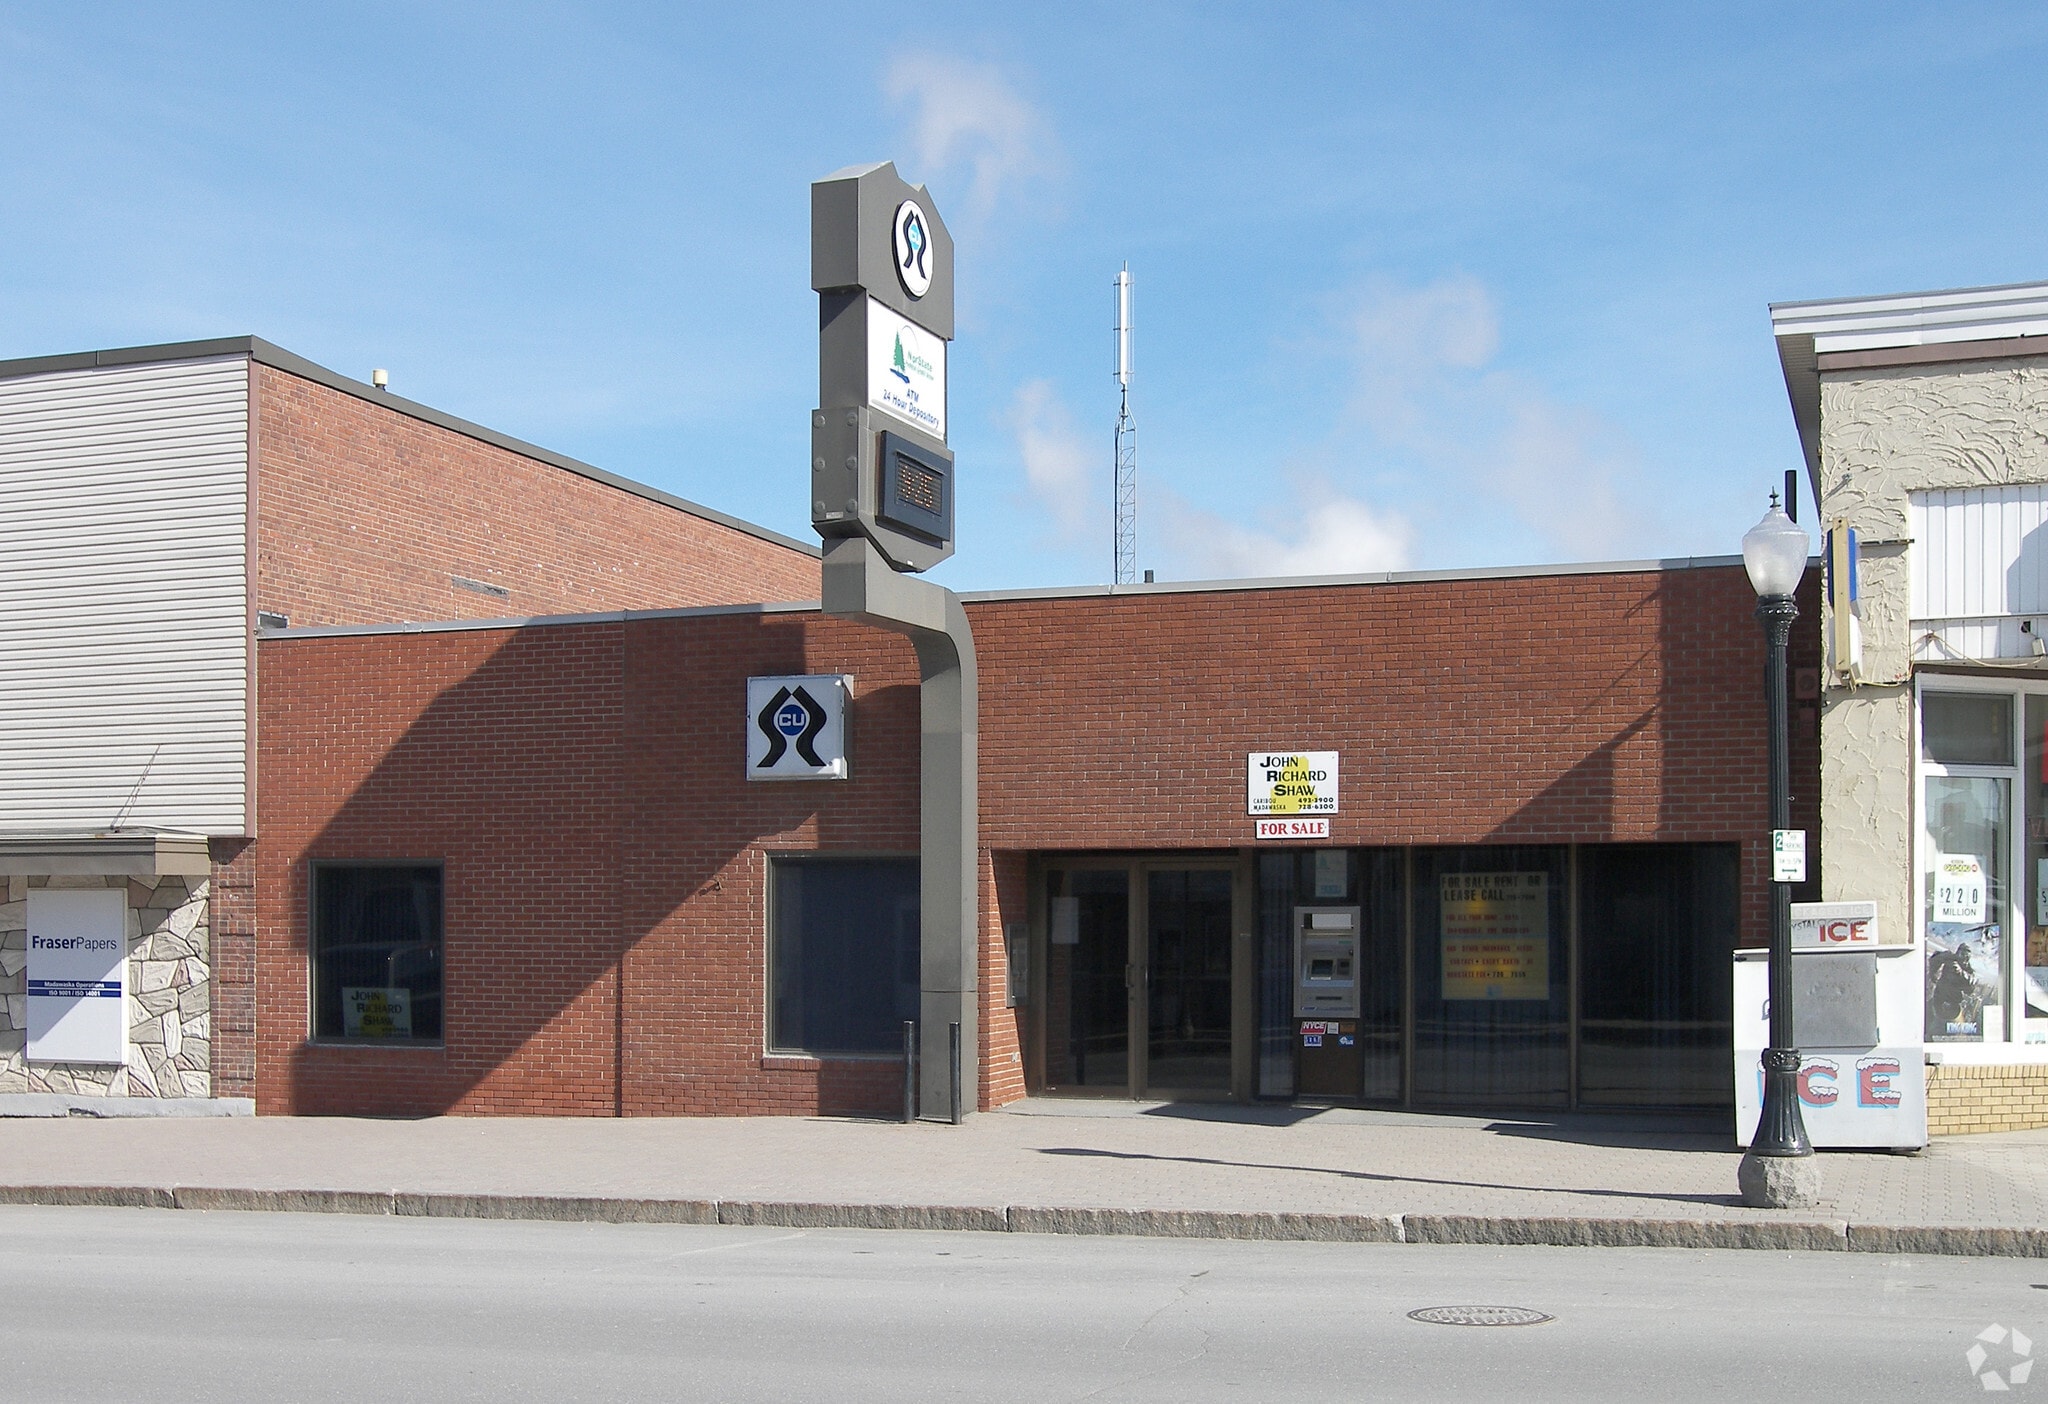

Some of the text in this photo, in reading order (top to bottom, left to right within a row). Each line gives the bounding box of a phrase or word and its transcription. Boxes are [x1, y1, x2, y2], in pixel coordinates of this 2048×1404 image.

[907, 389, 919, 402] ATM
[883, 389, 939, 428] 24 Hour Depository
[779, 713, 805, 727] CU
[1260, 756, 1298, 767] JOHN
[1267, 770, 1327, 782] RICHARD
[1274, 785, 1315, 796] SHAW
[1261, 822, 1325, 835] FOR SALE
[1776, 835, 1783, 848] 2
[1441, 876, 1460, 888] FOR
[1464, 876, 1490, 888] SALE
[1494, 875, 1518, 887] RENT
[1444, 889, 1476, 901] LEASE
[1481, 889, 1504, 901] CALL
[1794, 906, 1842, 917] CKAGED
[1943, 908, 1977, 916] MILLION
[1791, 919, 1868, 942] YSTAL ICE
[32, 935, 117, 952] FraserPapers
[76, 981, 105, 989] Operations
[351, 990, 380, 1000] JOHN
[356, 1003, 402, 1013] RICHARD
[363, 1015, 394, 1026] SHAW
[1303, 1021, 1326, 1029] NYCE
